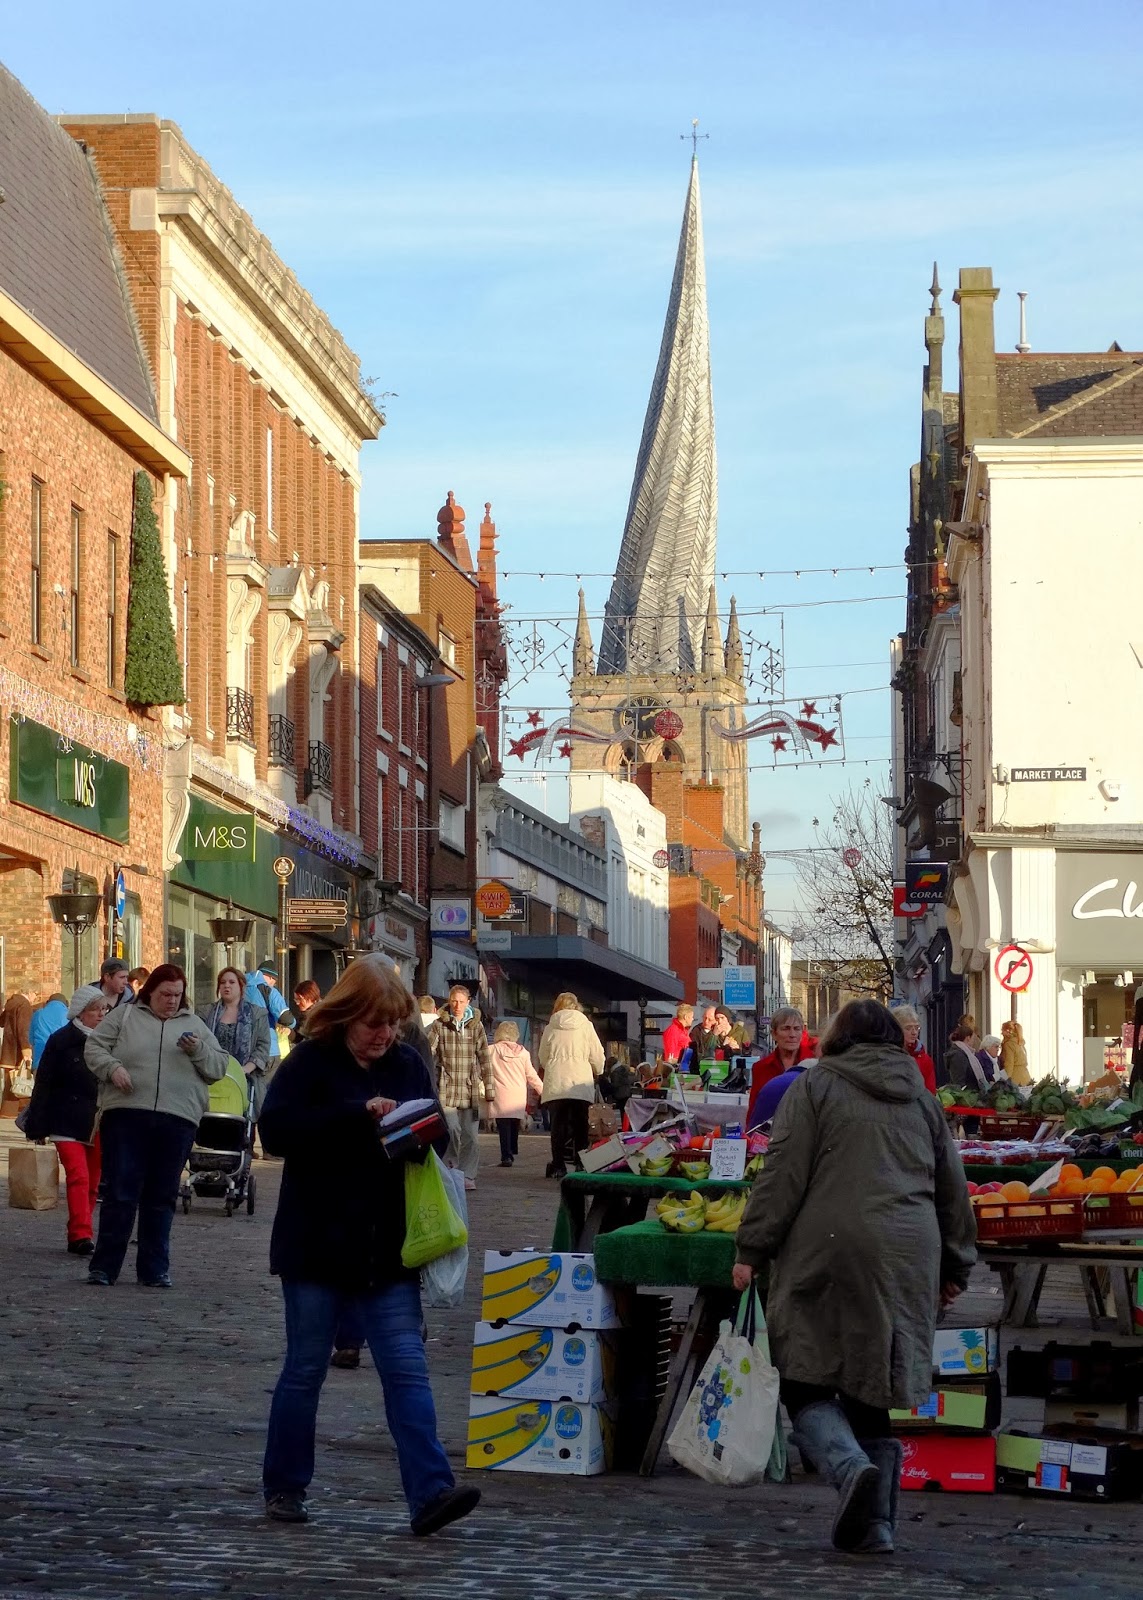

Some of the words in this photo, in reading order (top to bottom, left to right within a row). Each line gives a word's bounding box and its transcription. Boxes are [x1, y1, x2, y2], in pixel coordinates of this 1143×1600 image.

[1015, 770, 1051, 780] MARKET
[1055, 769, 1083, 779] PLACE
[74, 758, 96, 808] M&S
[194, 826, 247, 849] M&S
[480, 892, 506, 901] KWIK
[909, 891, 944, 899] CORAL
[484, 901, 503, 909] TAN
[555, 1423, 581, 1433] Chiquita
[906, 1466, 931, 1480] Lady
